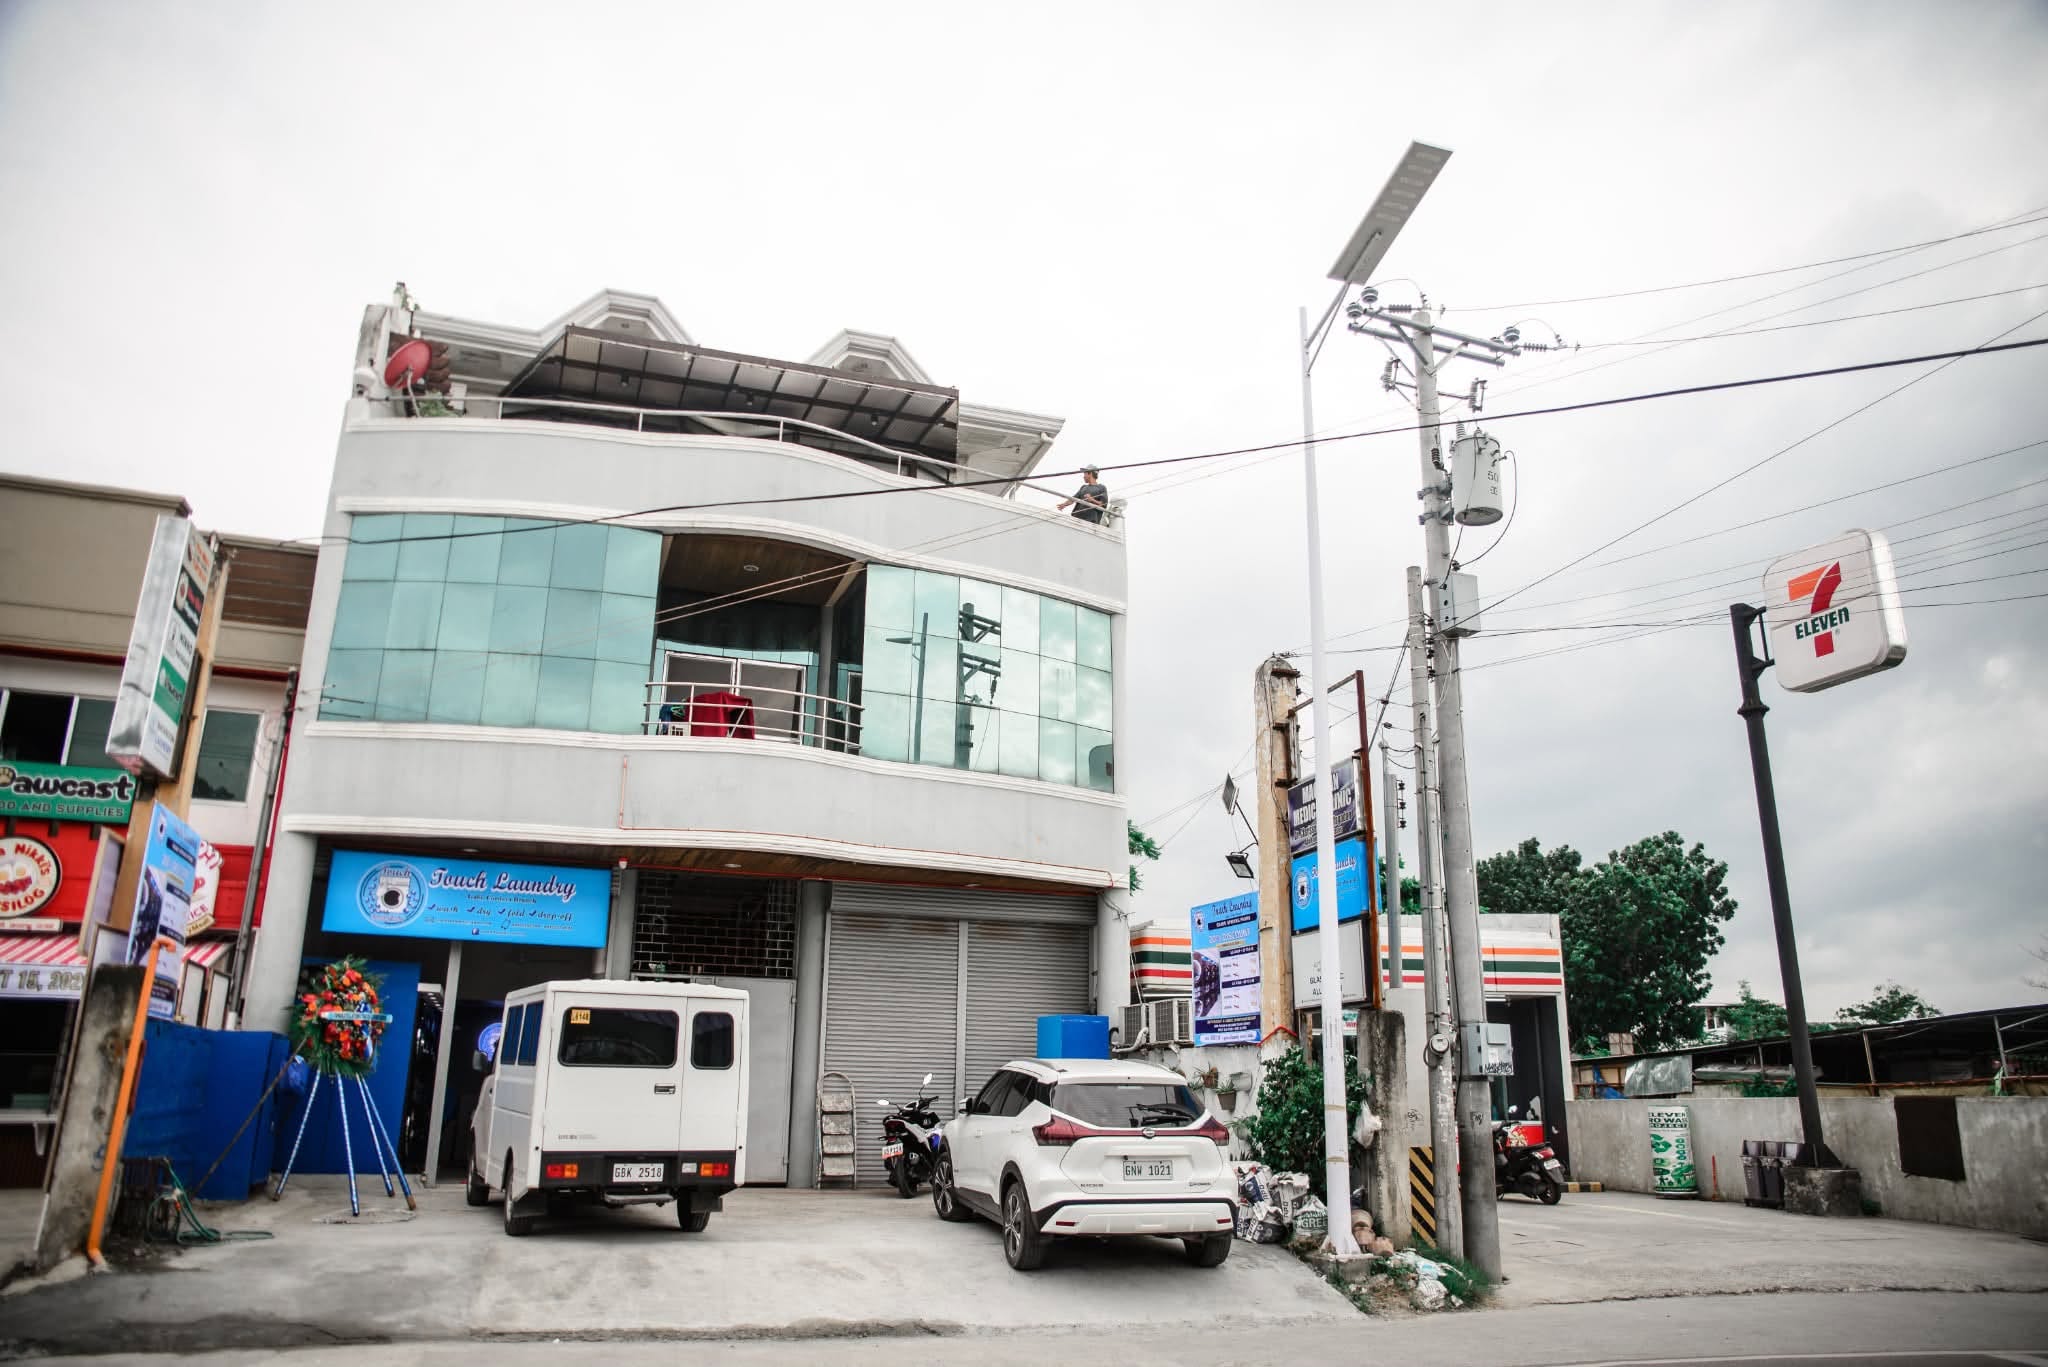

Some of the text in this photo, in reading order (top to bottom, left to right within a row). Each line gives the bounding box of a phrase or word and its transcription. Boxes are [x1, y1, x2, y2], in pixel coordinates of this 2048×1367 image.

[21, 802, 51, 812] AND
[57, 804, 124, 817] SUPPLIES
[429, 867, 577, 903] Touch Laundry
[48, 971, 84, 991] 202
[614, 1167, 662, 1178] GBK 2518
[1125, 1165, 1171, 1176] GNW 1021
